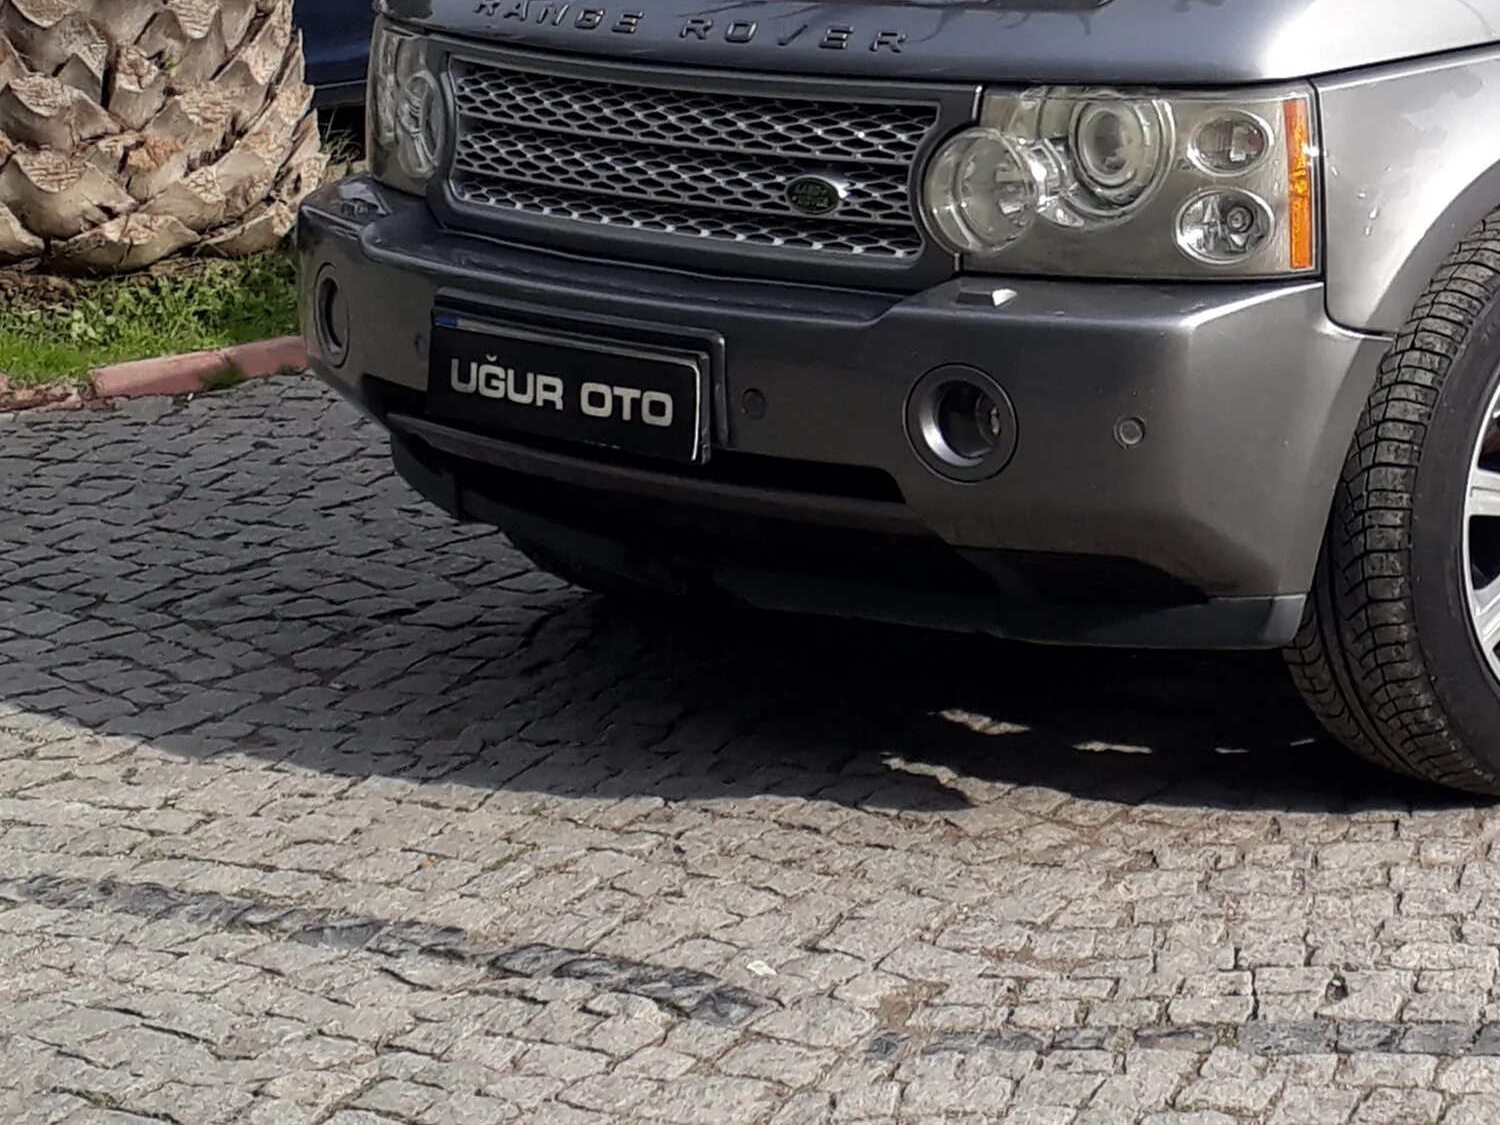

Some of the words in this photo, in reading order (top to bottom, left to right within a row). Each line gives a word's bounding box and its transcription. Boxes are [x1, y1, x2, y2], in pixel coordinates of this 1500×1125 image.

[678, 17, 908, 54] ROVER
[450, 353, 564, 411] UĞUR
[580, 381, 674, 427] OTO
